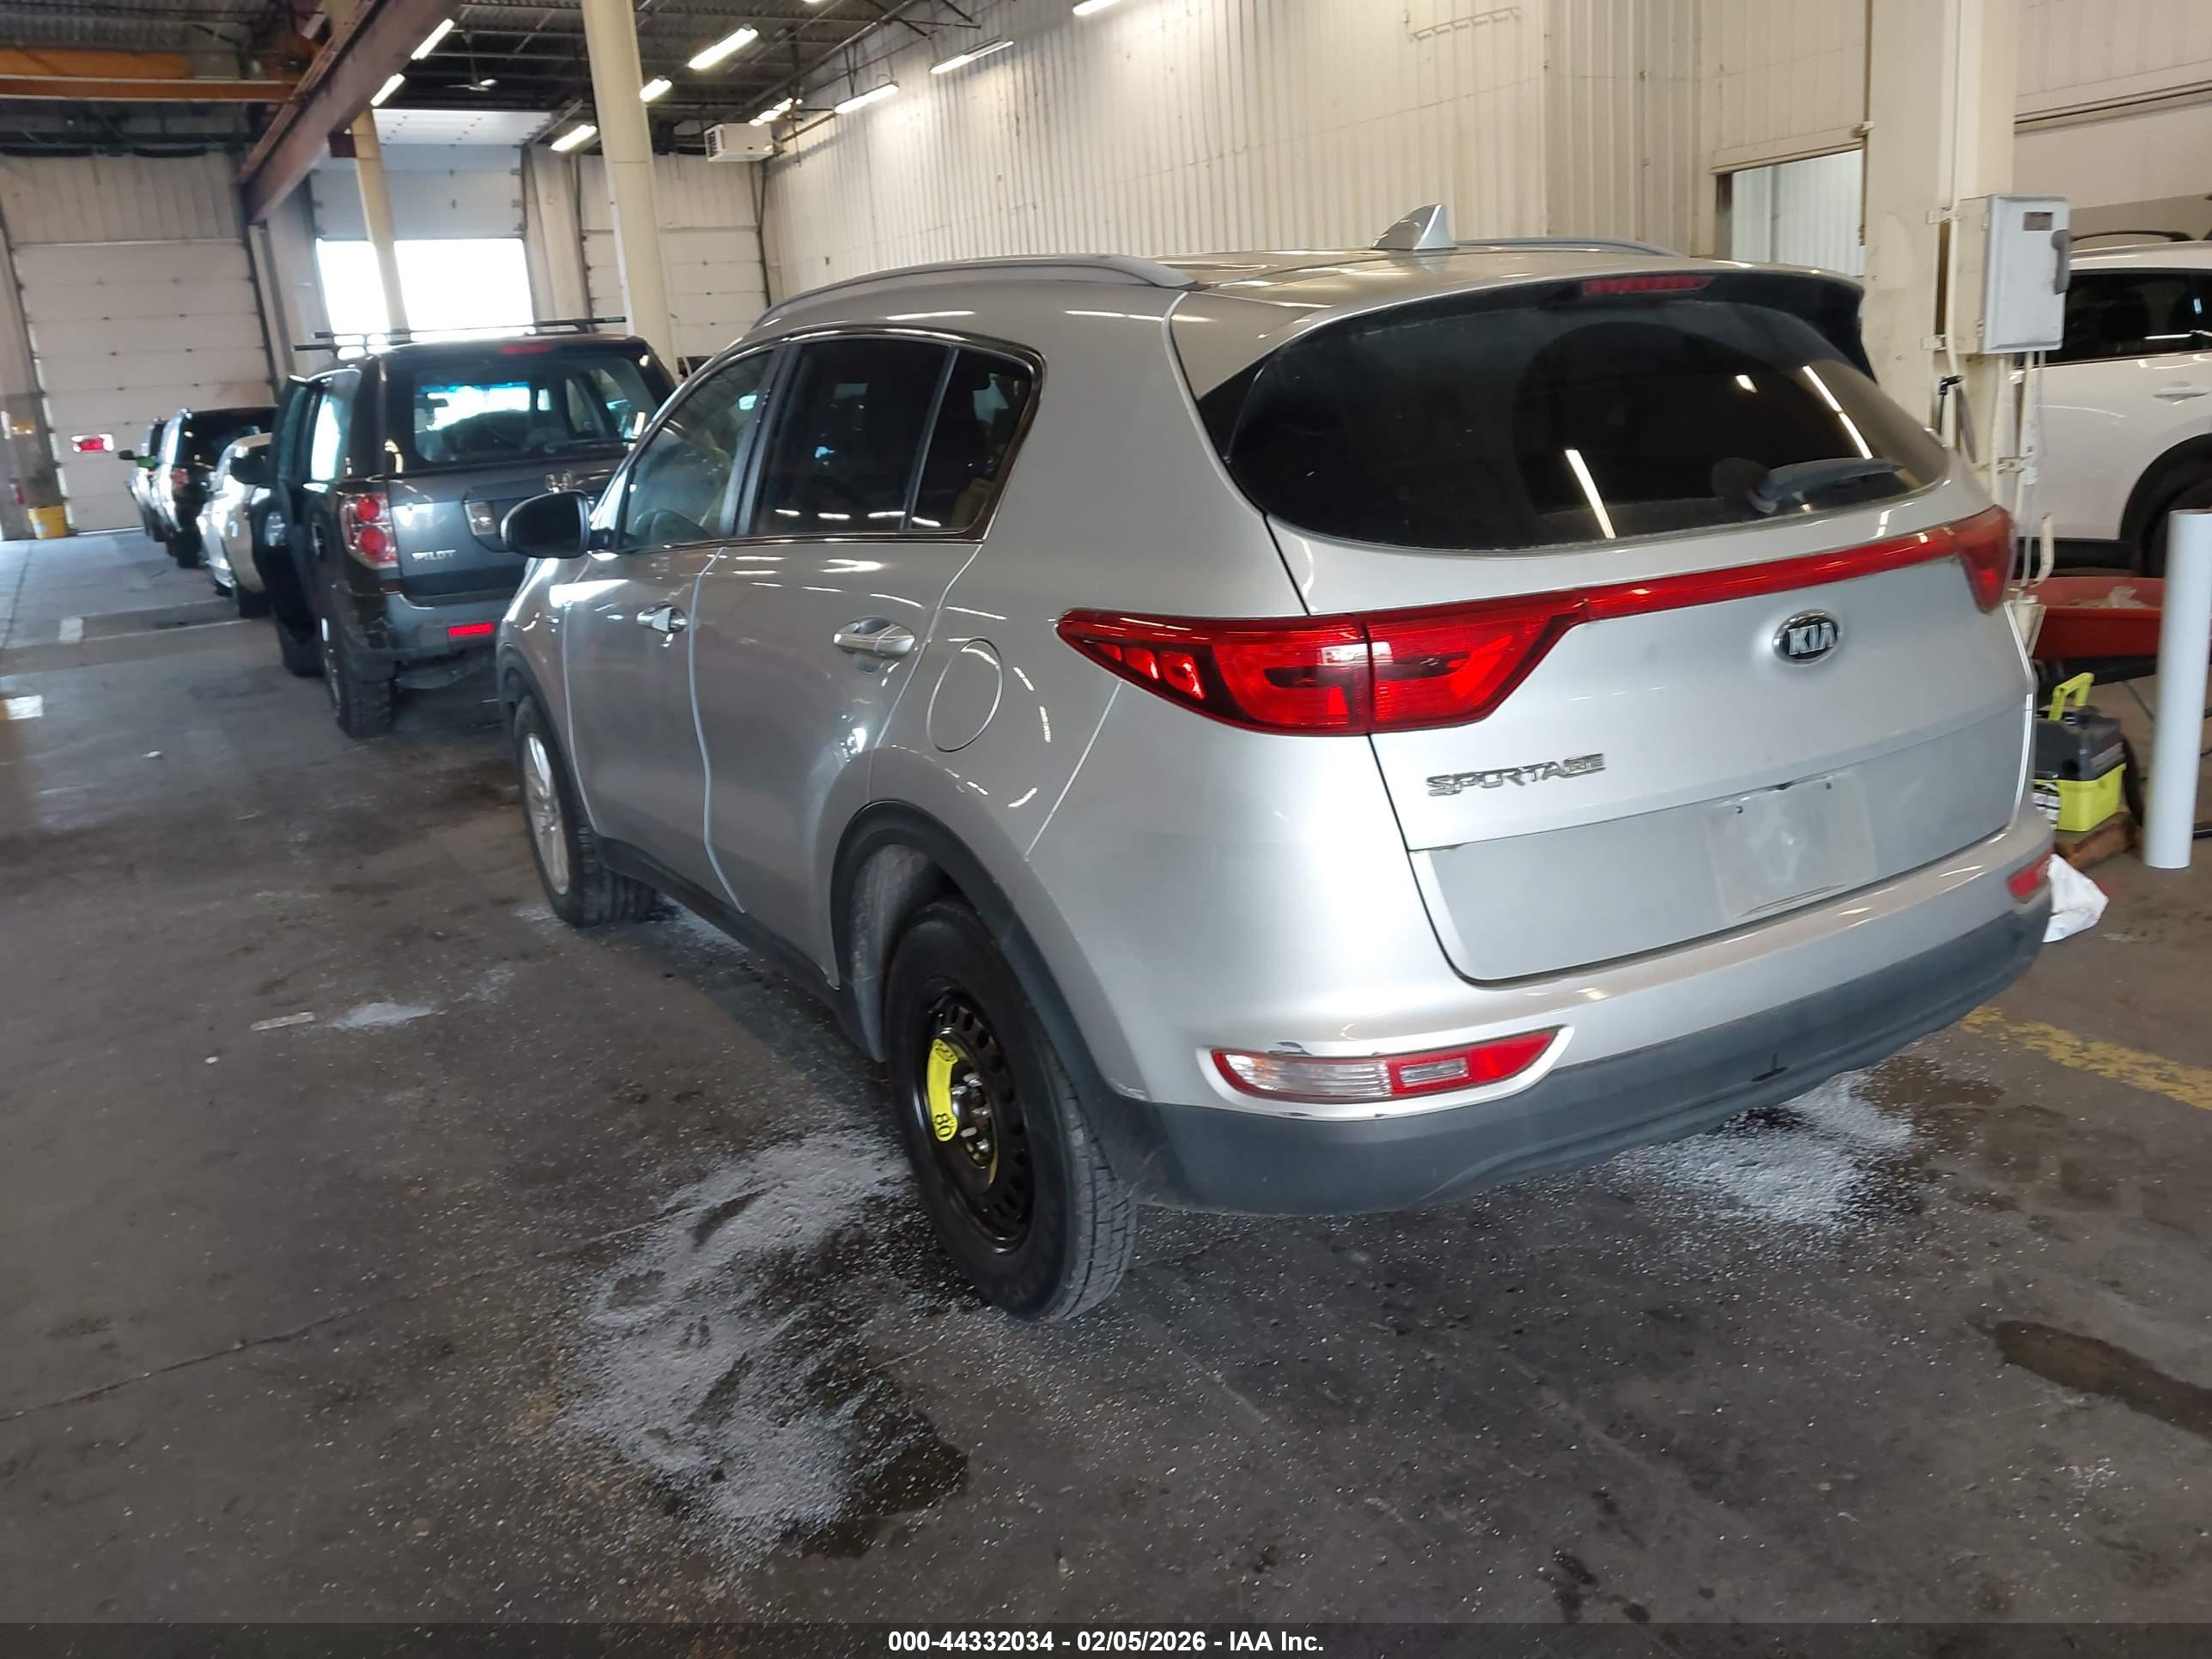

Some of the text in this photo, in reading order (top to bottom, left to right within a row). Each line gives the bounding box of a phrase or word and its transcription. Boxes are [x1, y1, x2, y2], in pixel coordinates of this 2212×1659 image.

[411, 549, 457, 562] PILOT
[1788, 622, 1835, 655] KIA
[1426, 752, 1606, 797] SPORTAGE
